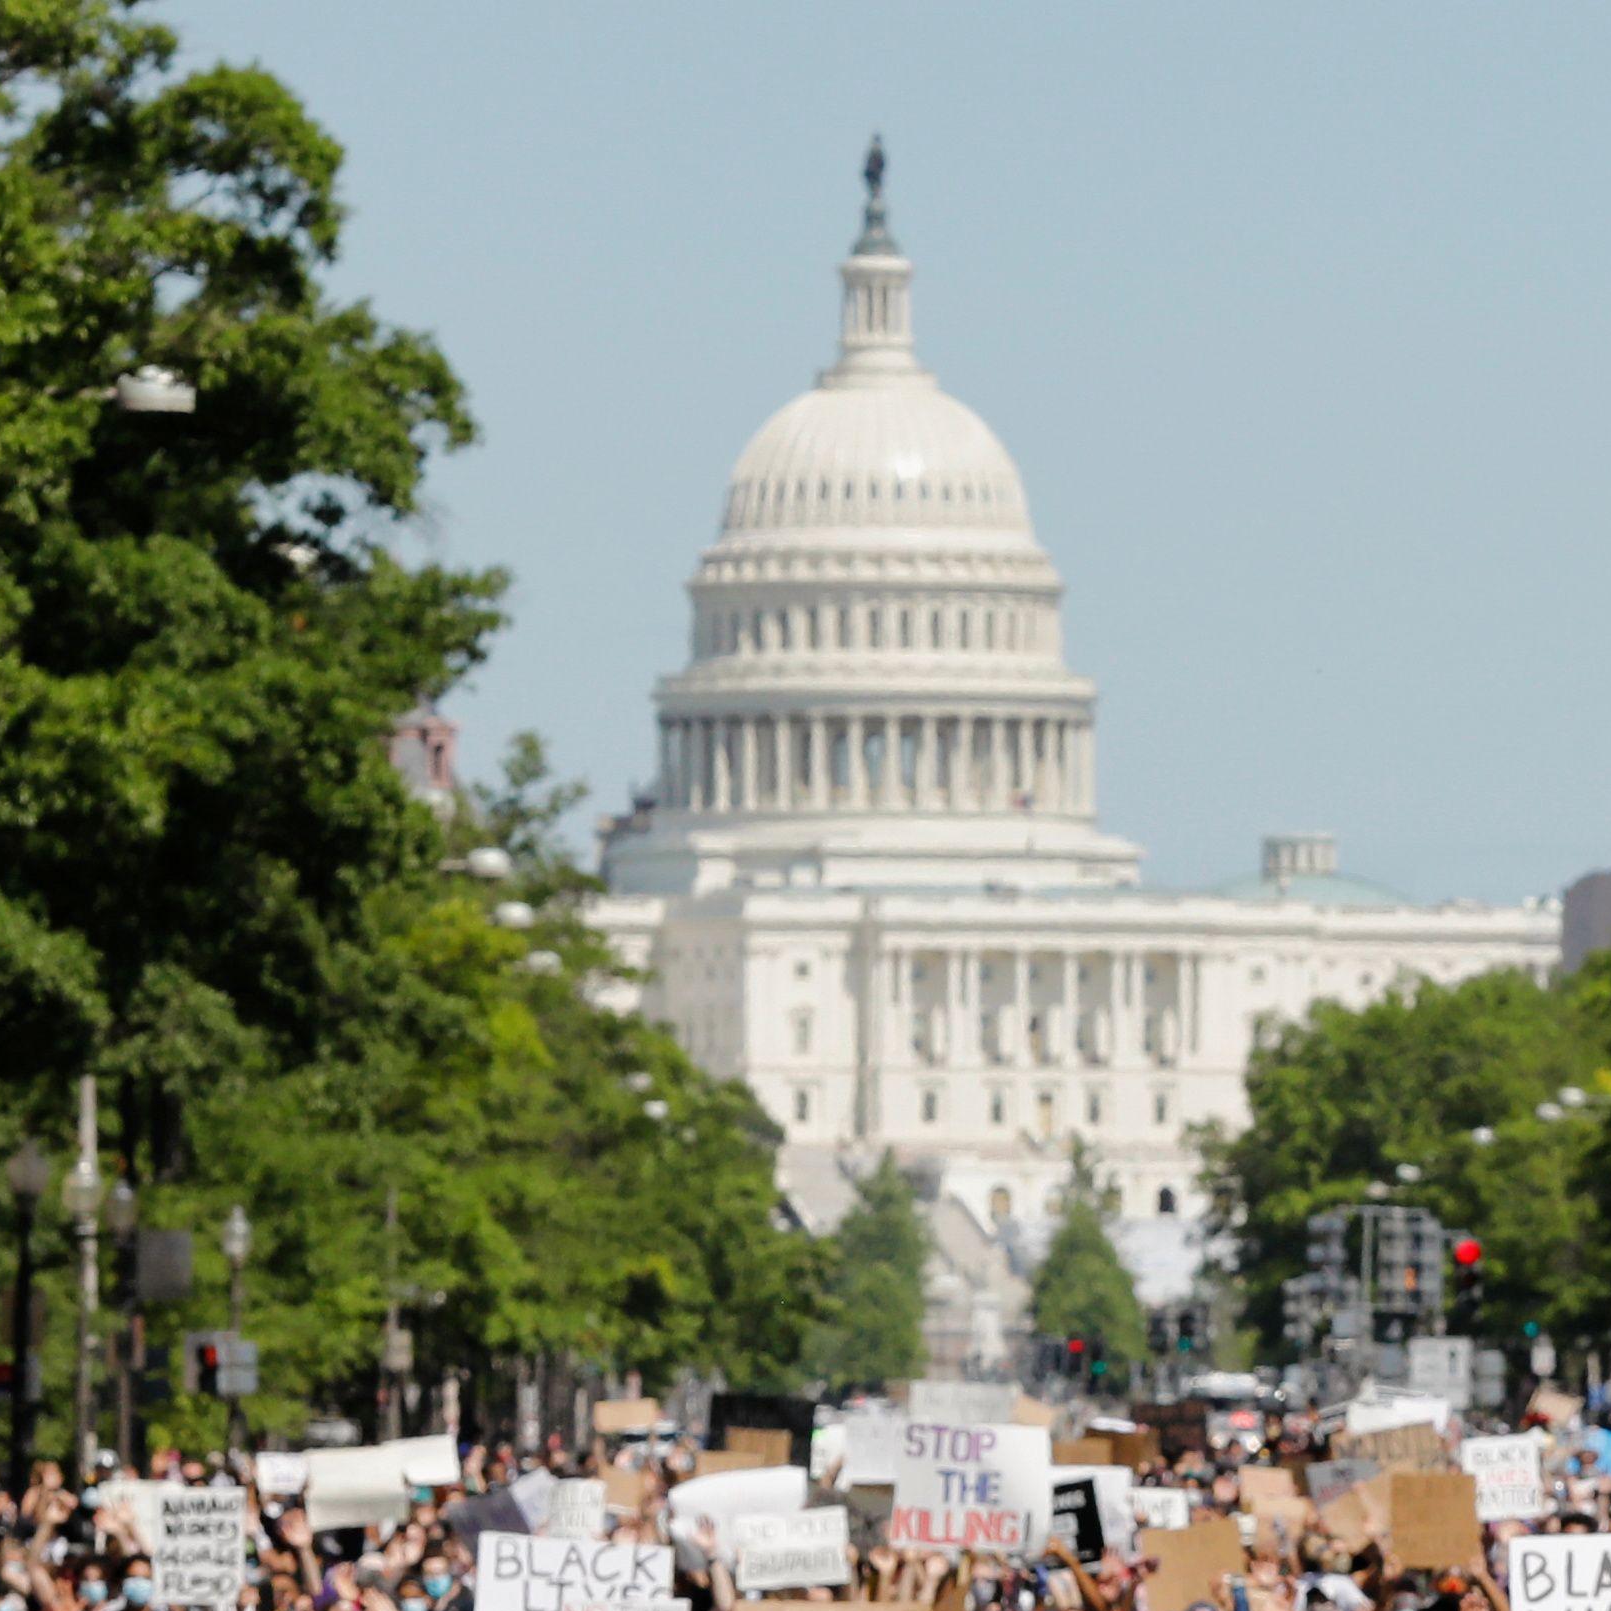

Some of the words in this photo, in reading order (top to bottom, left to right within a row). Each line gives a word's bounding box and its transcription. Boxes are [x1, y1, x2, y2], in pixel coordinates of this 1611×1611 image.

[905, 1424, 997, 1463] STOP
[939, 1468, 1002, 1504] THE
[891, 1506, 1032, 1548] KILLING!
[495, 1536, 657, 1583] BLACK
